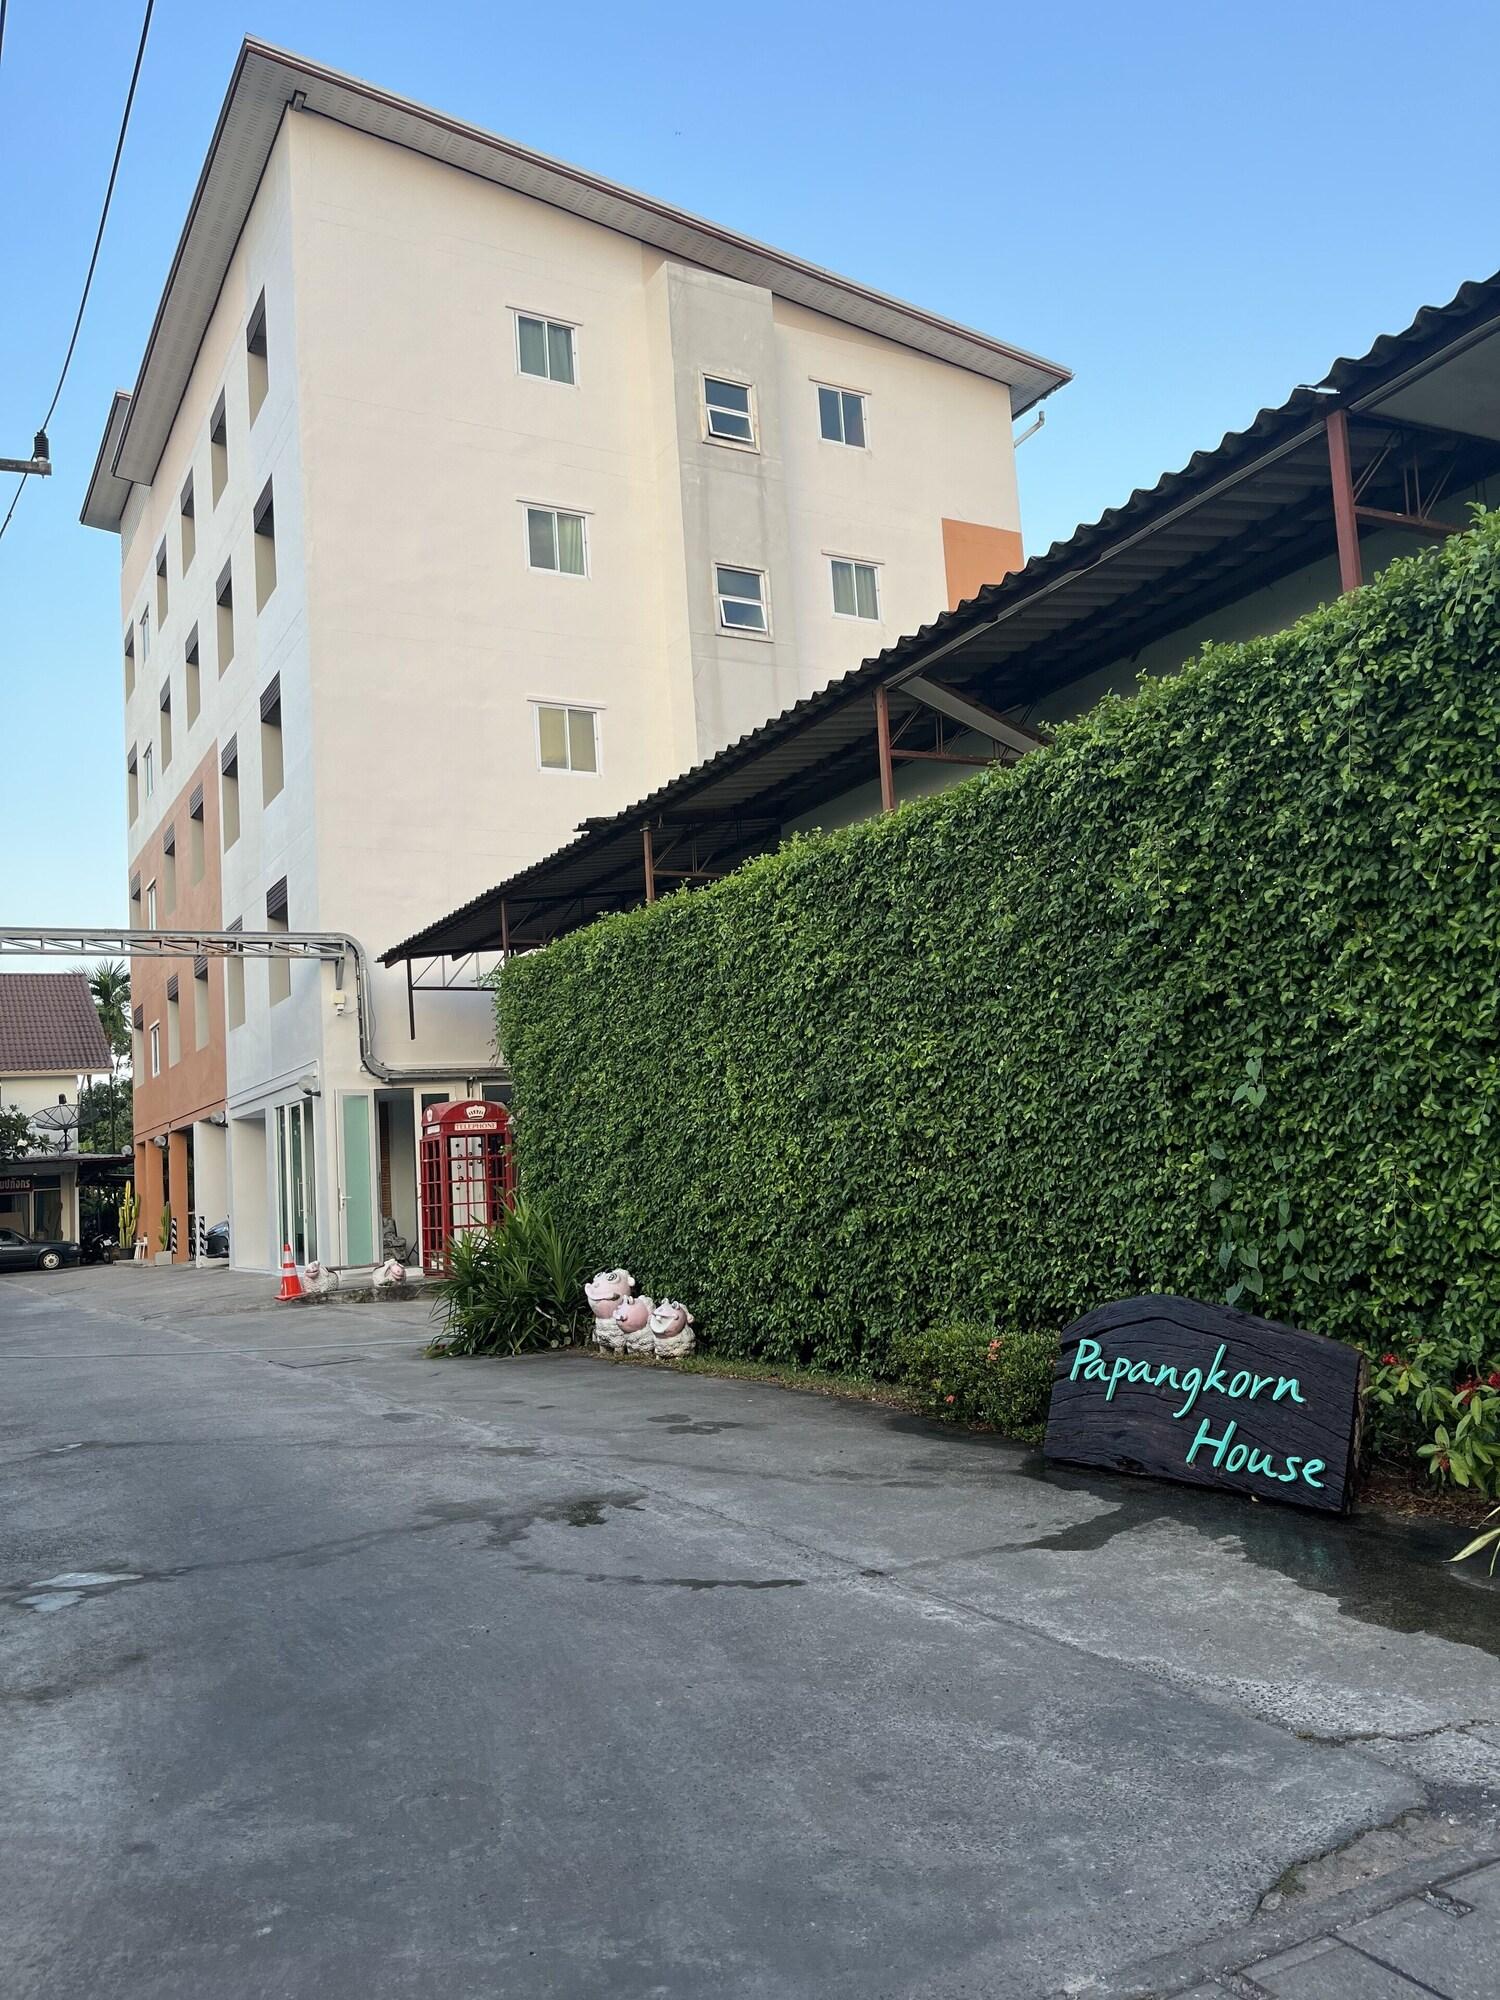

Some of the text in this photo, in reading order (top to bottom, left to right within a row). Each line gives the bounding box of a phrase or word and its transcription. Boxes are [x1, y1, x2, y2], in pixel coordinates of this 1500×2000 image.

[455, 1122, 496, 1130] TELEPHONE
[1069, 1339, 1306, 1418] Papangkorn
[1186, 1418, 1326, 1488] House
